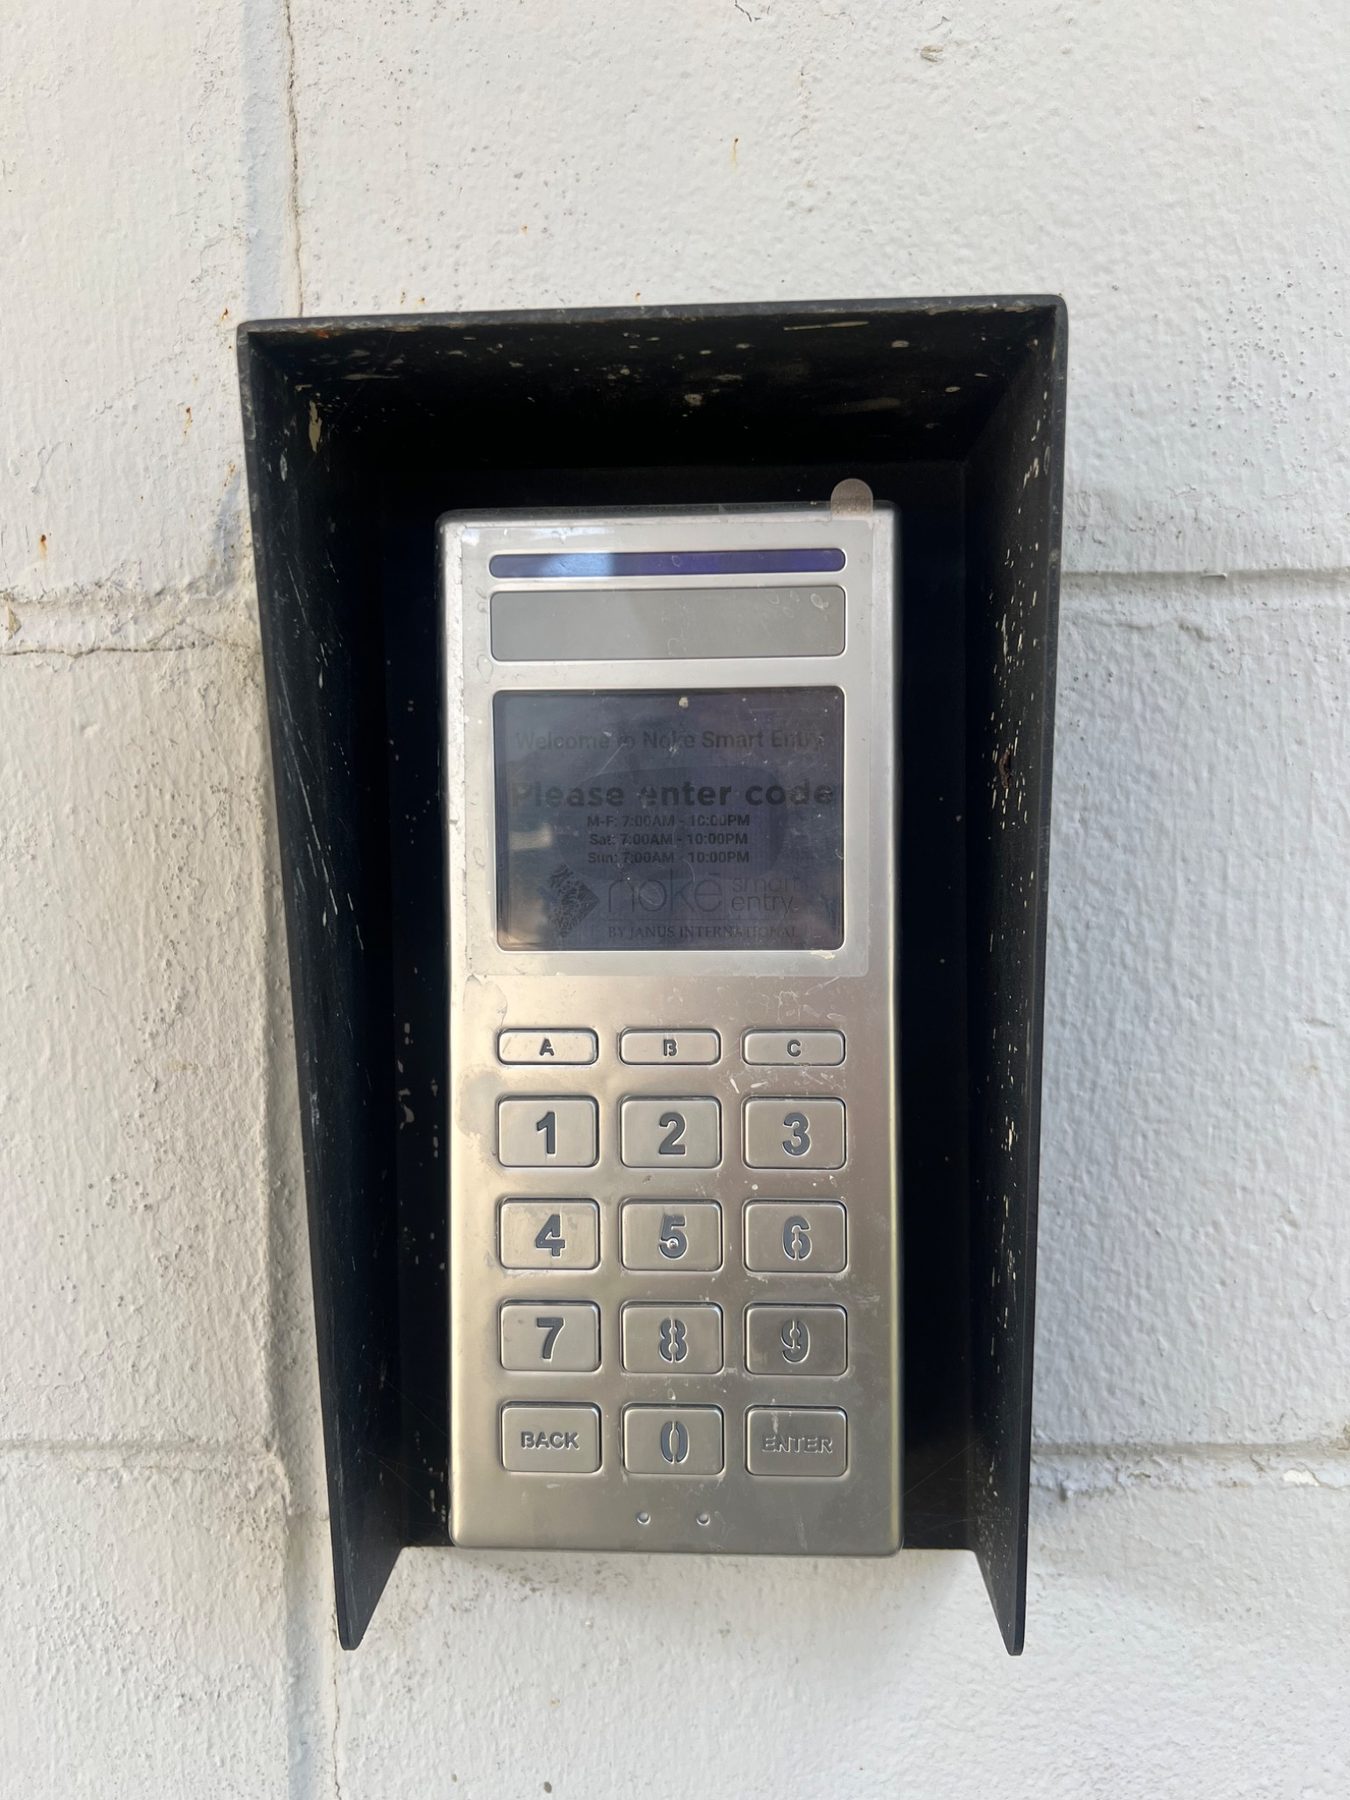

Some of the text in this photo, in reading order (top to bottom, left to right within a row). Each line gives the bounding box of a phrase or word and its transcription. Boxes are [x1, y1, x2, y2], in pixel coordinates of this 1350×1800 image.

[702, 729, 764, 749] Smart
[511, 780, 835, 807] Please enter code
[687, 832, 748, 845] 10:00PM
[688, 851, 749, 864] 10:00PM
[629, 925, 675, 939] JANUS
[538, 1039, 555, 1057] A
[663, 1039, 678, 1056] B
[786, 1039, 802, 1057] C
[535, 1111, 557, 1155] 1
[658, 1112, 687, 1155] 2
[781, 1111, 811, 1156] 3
[534, 1214, 566, 1257] 4
[657, 1215, 688, 1260] 5
[781, 1215, 811, 1261] 6
[535, 1316, 564, 1361] 7
[658, 1317, 689, 1363] 8
[780, 1318, 811, 1364] 9
[520, 1430, 580, 1451] BACK
[659, 1420, 690, 1464] 0
[761, 1434, 833, 1455] ENTER
